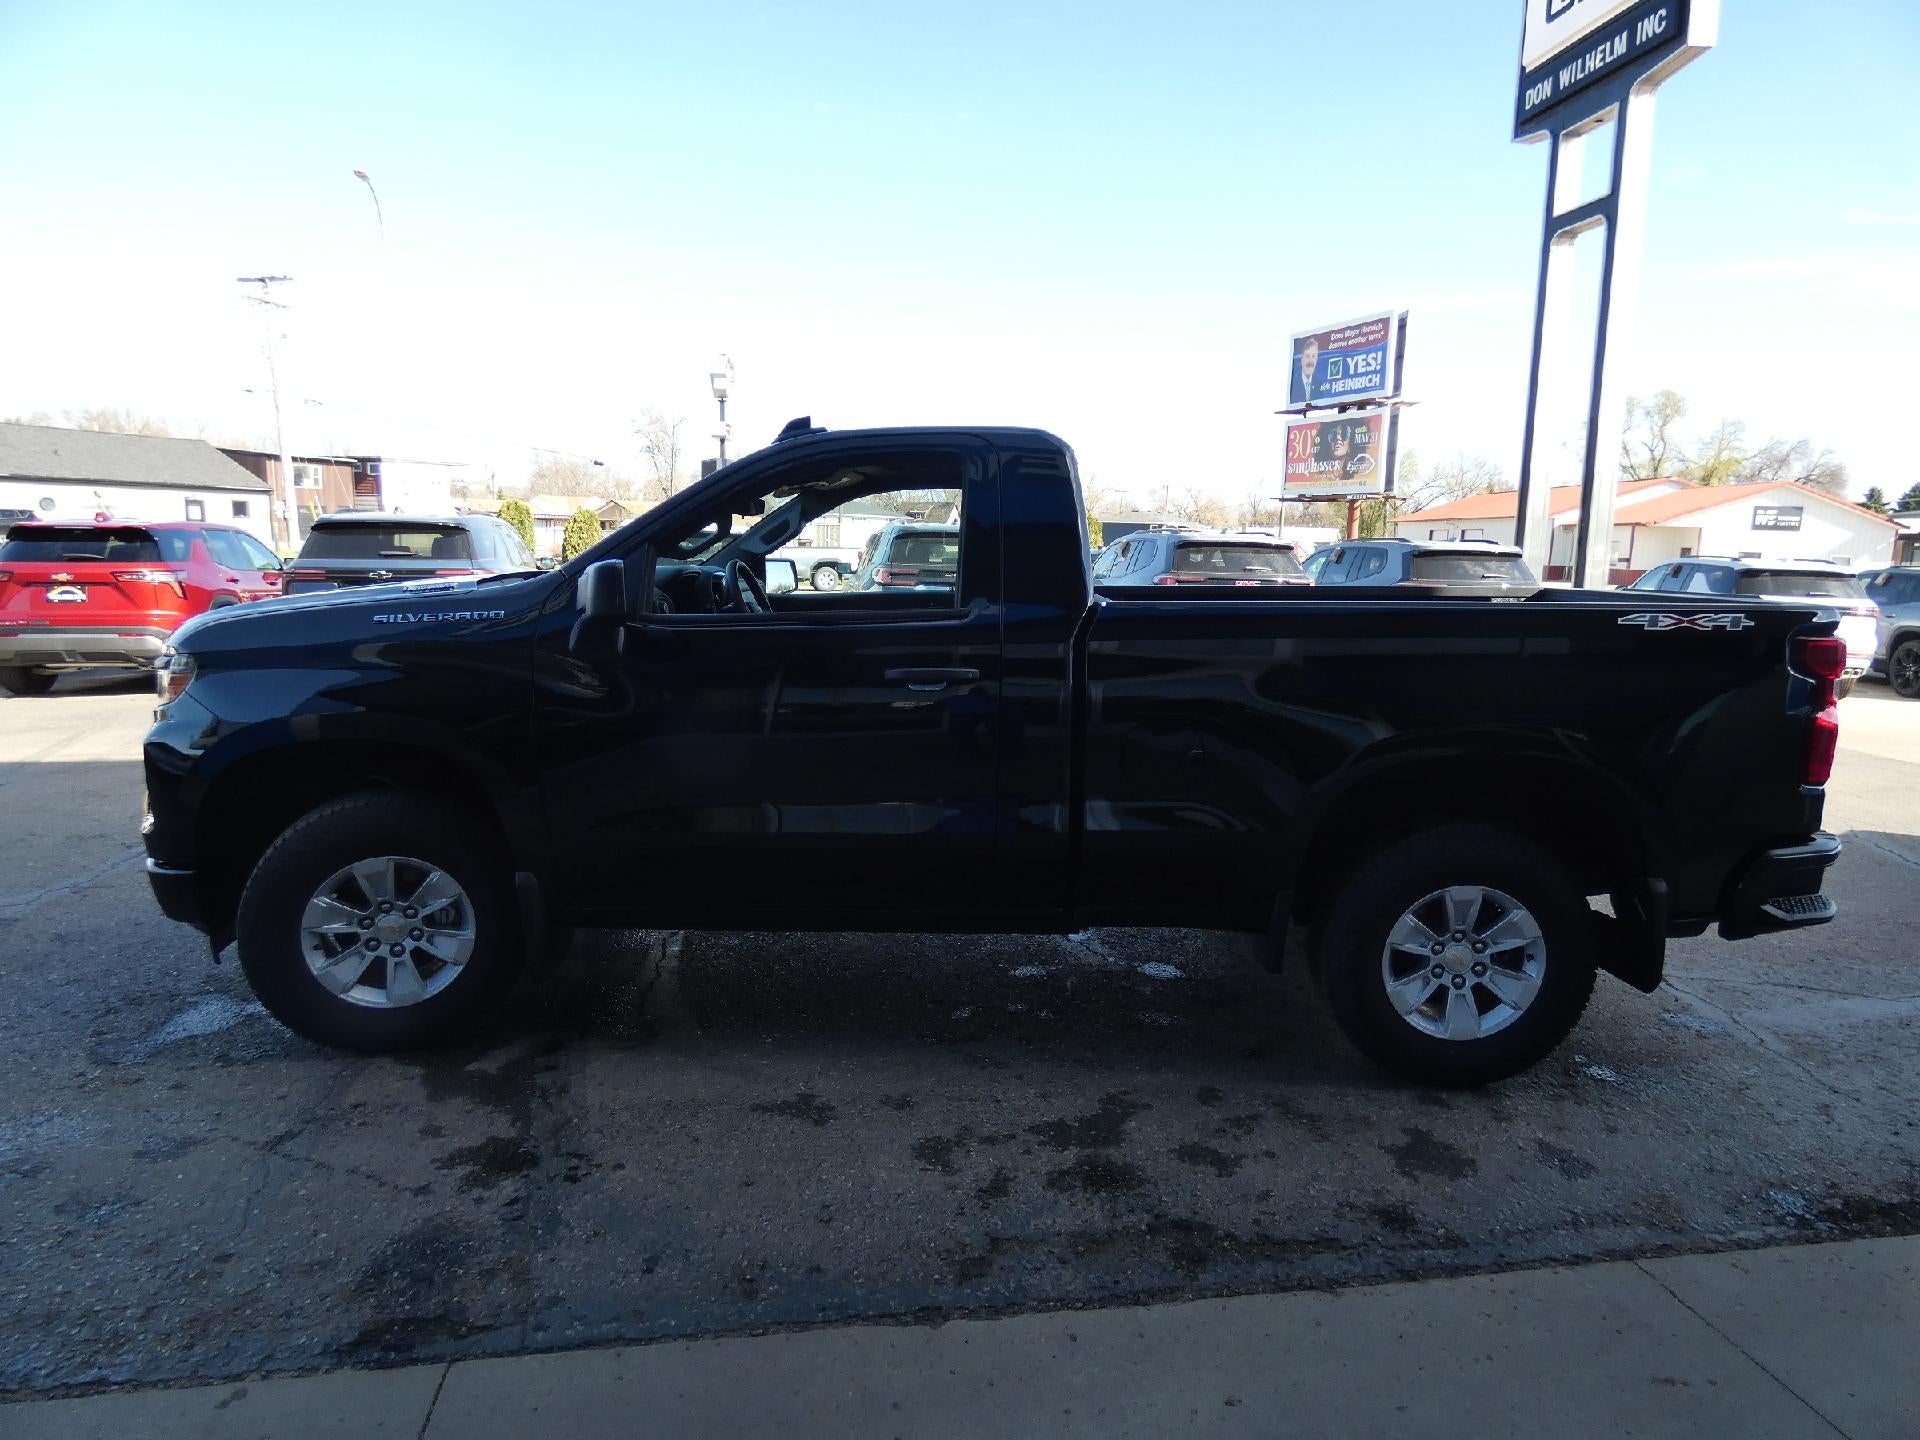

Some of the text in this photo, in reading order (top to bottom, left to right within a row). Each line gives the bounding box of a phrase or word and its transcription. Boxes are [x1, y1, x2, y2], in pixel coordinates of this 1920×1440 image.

[1525, 8, 1667, 110] DON WILHELM INC
[1346, 351, 1382, 375] YES!
[1331, 374, 1380, 393] HEINRICH
[373, 610, 505, 624] SILVERADO
